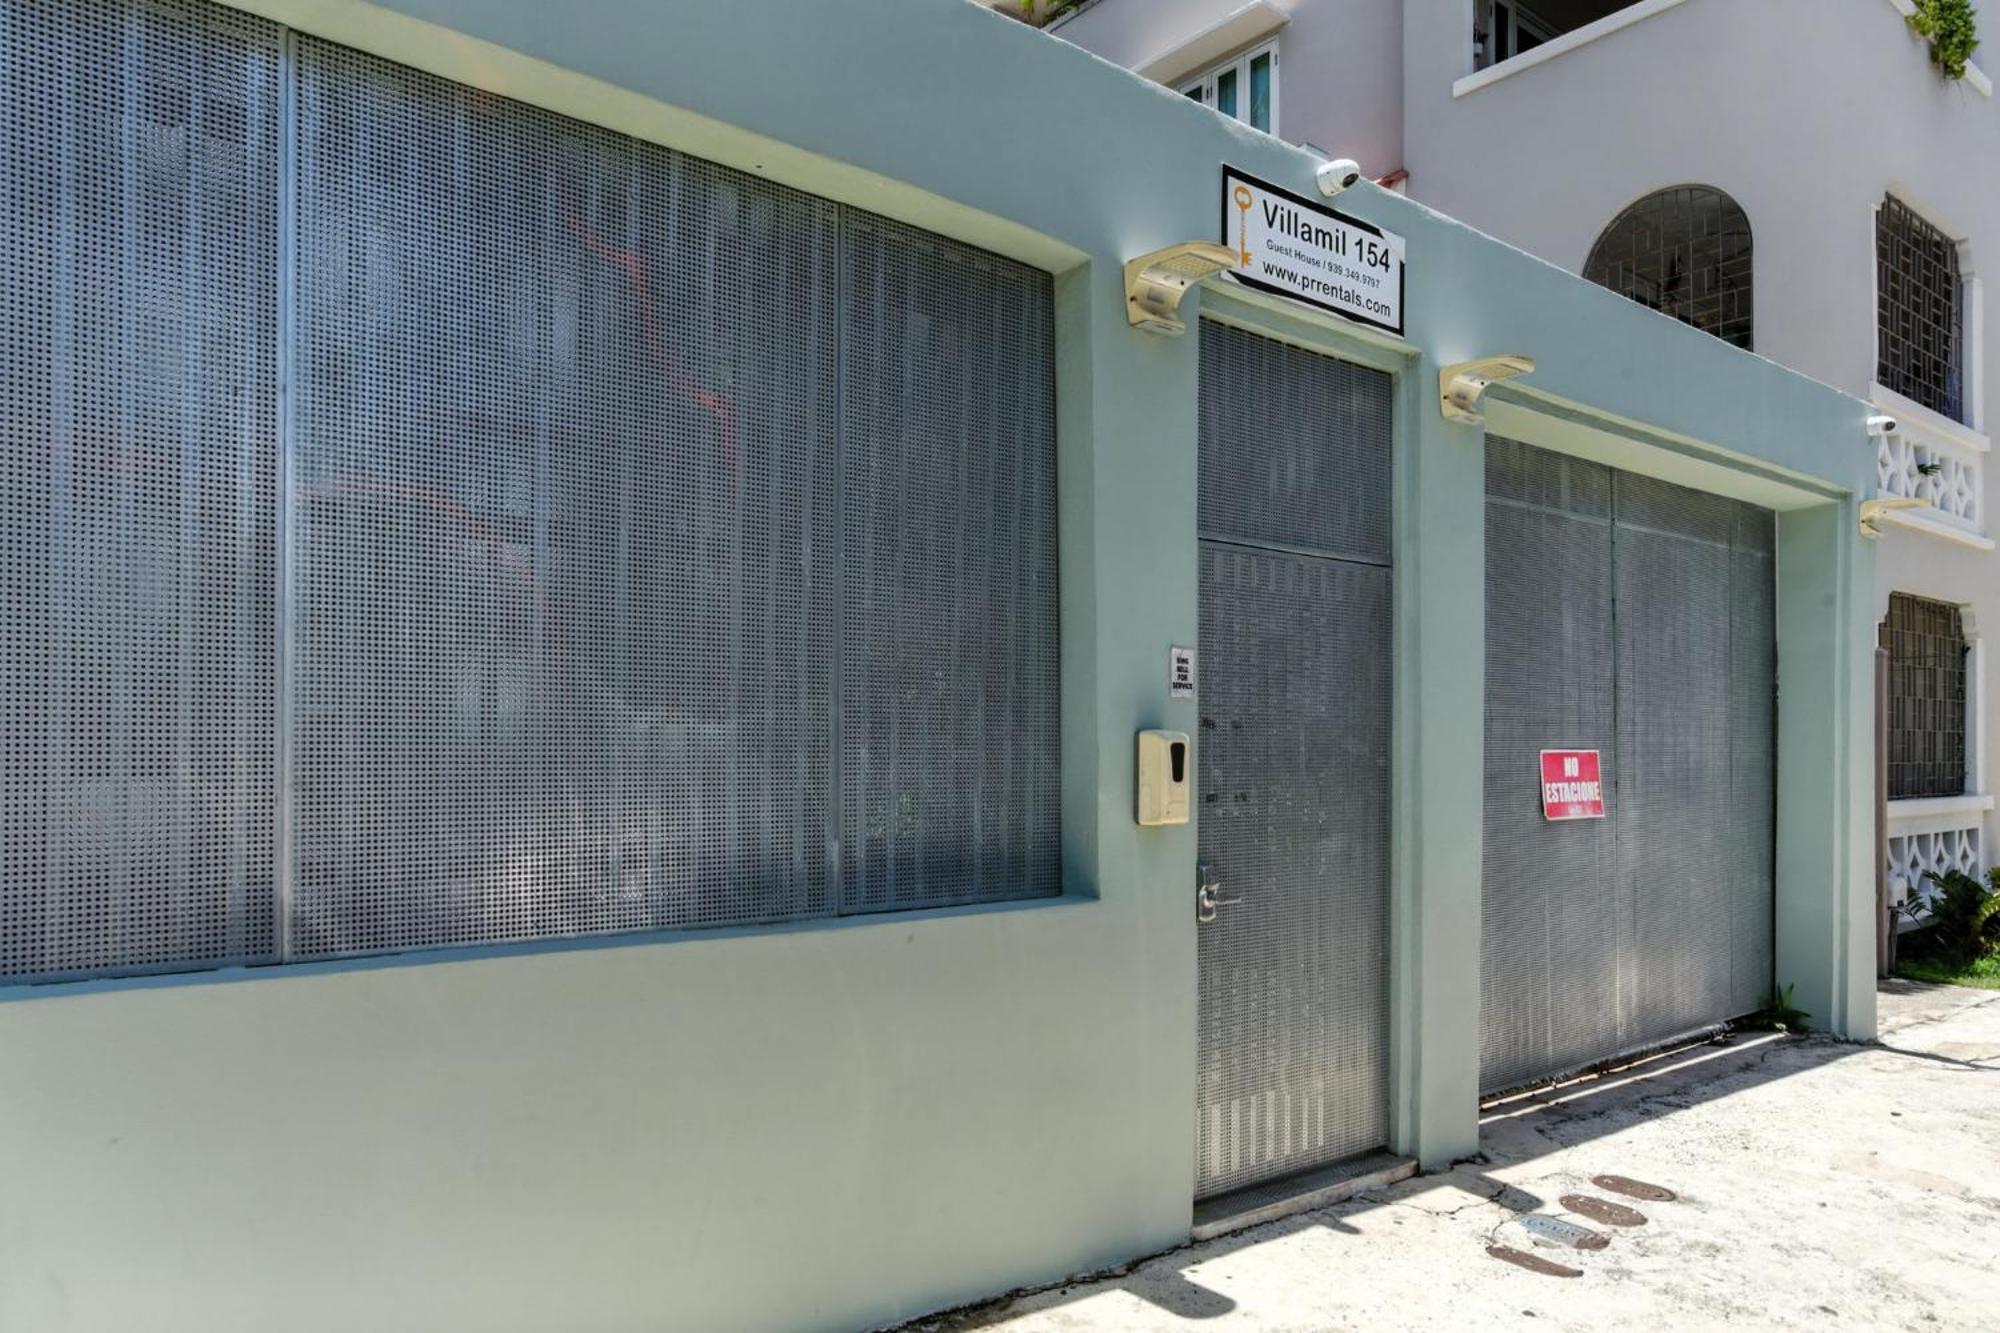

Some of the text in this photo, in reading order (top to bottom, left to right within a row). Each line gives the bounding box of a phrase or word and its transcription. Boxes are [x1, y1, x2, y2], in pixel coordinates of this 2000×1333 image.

[1263, 199, 1391, 273] Villamil 154
[1266, 239, 1293, 258] Guest
[1294, 249, 1320, 268] House
[1263, 261, 1391, 317] www.prrentals.com
[1172, 682, 1193, 690] SERVICE
[1564, 757, 1579, 777] NO
[1545, 782, 1600, 803] ESTACIONE
